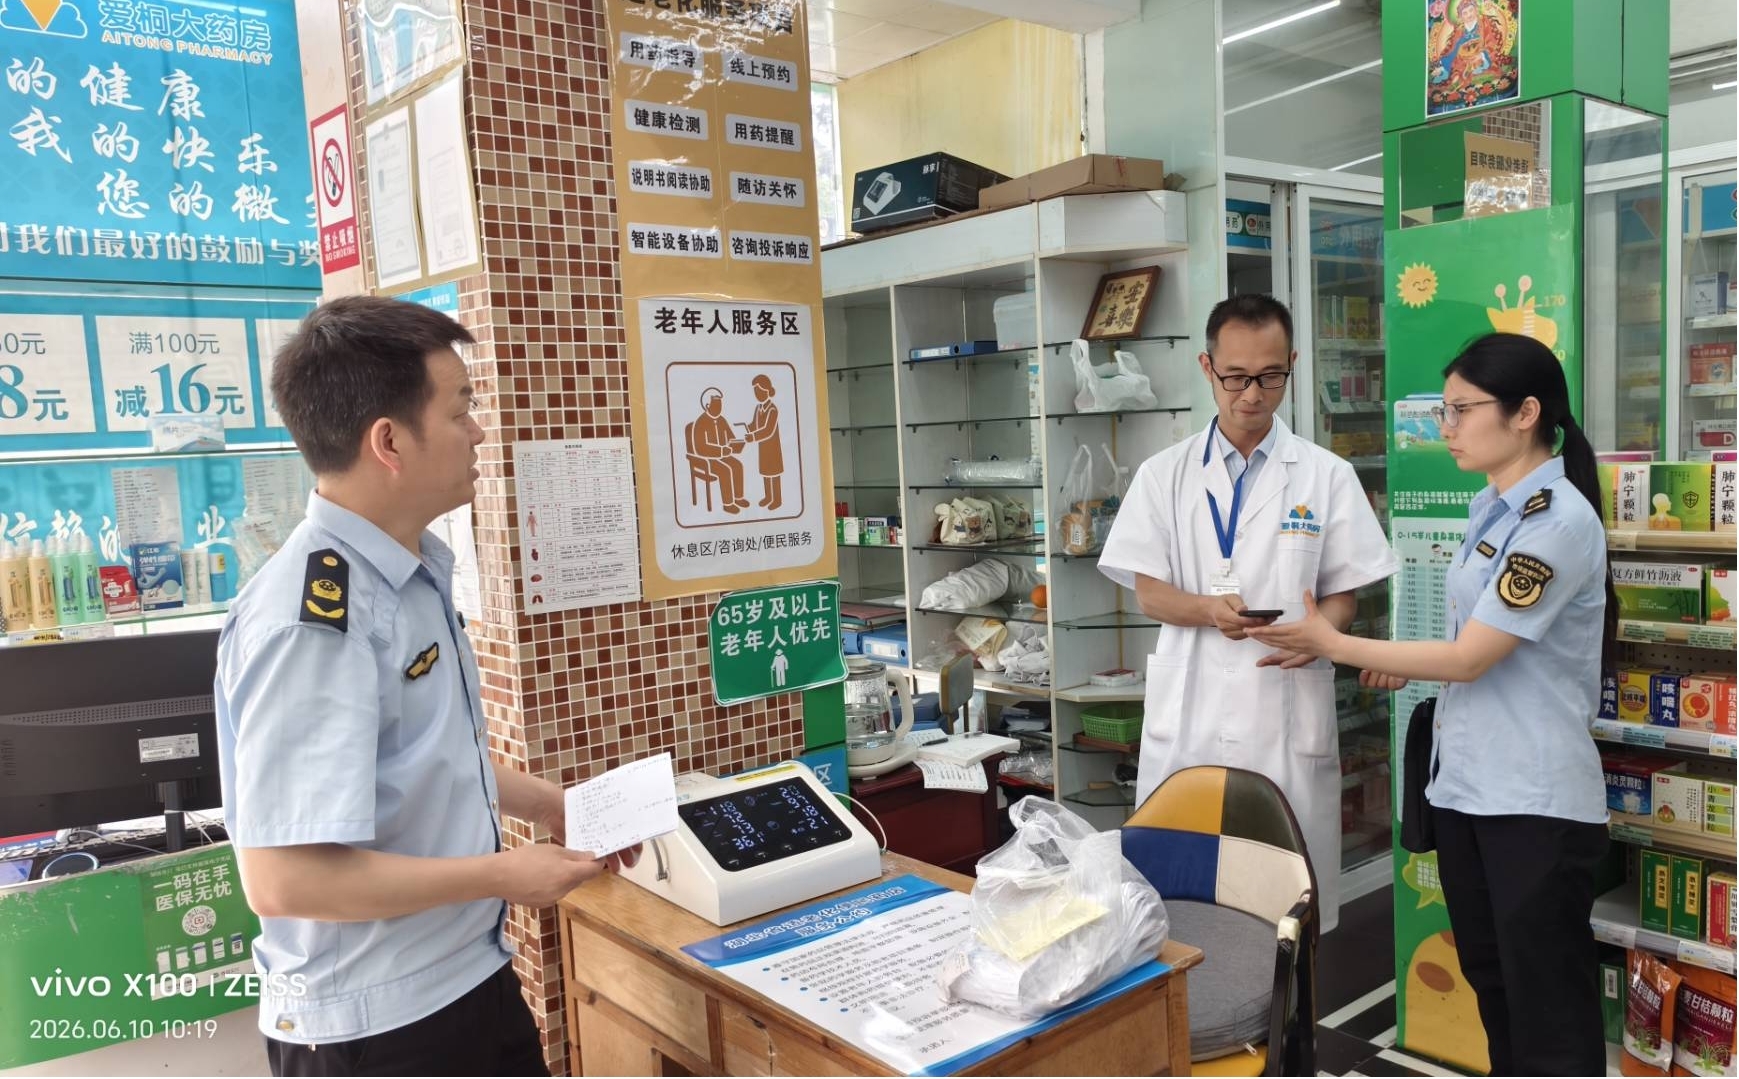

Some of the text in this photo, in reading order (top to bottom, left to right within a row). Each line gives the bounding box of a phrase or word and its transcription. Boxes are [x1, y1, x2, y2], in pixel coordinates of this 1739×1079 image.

[101, 1, 271, 51] 爱桐大药房
[102, 32, 273, 66] AITONG PHARMACY
[730, 58, 791, 83] 线上预约
[634, 107, 701, 134] 健康检测
[735, 122, 795, 146] 用药提醒
[631, 168, 710, 192] 说明书阅读协助
[737, 177, 797, 199] 随访关怀
[631, 229, 719, 254] 智能设备协助
[732, 237, 810, 260] 咨询投诉响应
[654, 306, 801, 336] 老年人服务区
[0, 332, 46, 356] 0元
[129, 331, 221, 355] 满100元
[114, 363, 245, 418] 减16元
[1623, 471, 1635, 523] 肺宁颗粒
[1721, 470, 1736, 526] 肺宁颗粒
[671, 531, 812, 560] 休息区/咨询处/便民服务
[717, 590, 832, 627] 65岁及以上
[720, 617, 831, 657] 老年人优先
[153, 863, 231, 889] 一码在手
[156, 880, 233, 912] 医保无忧
